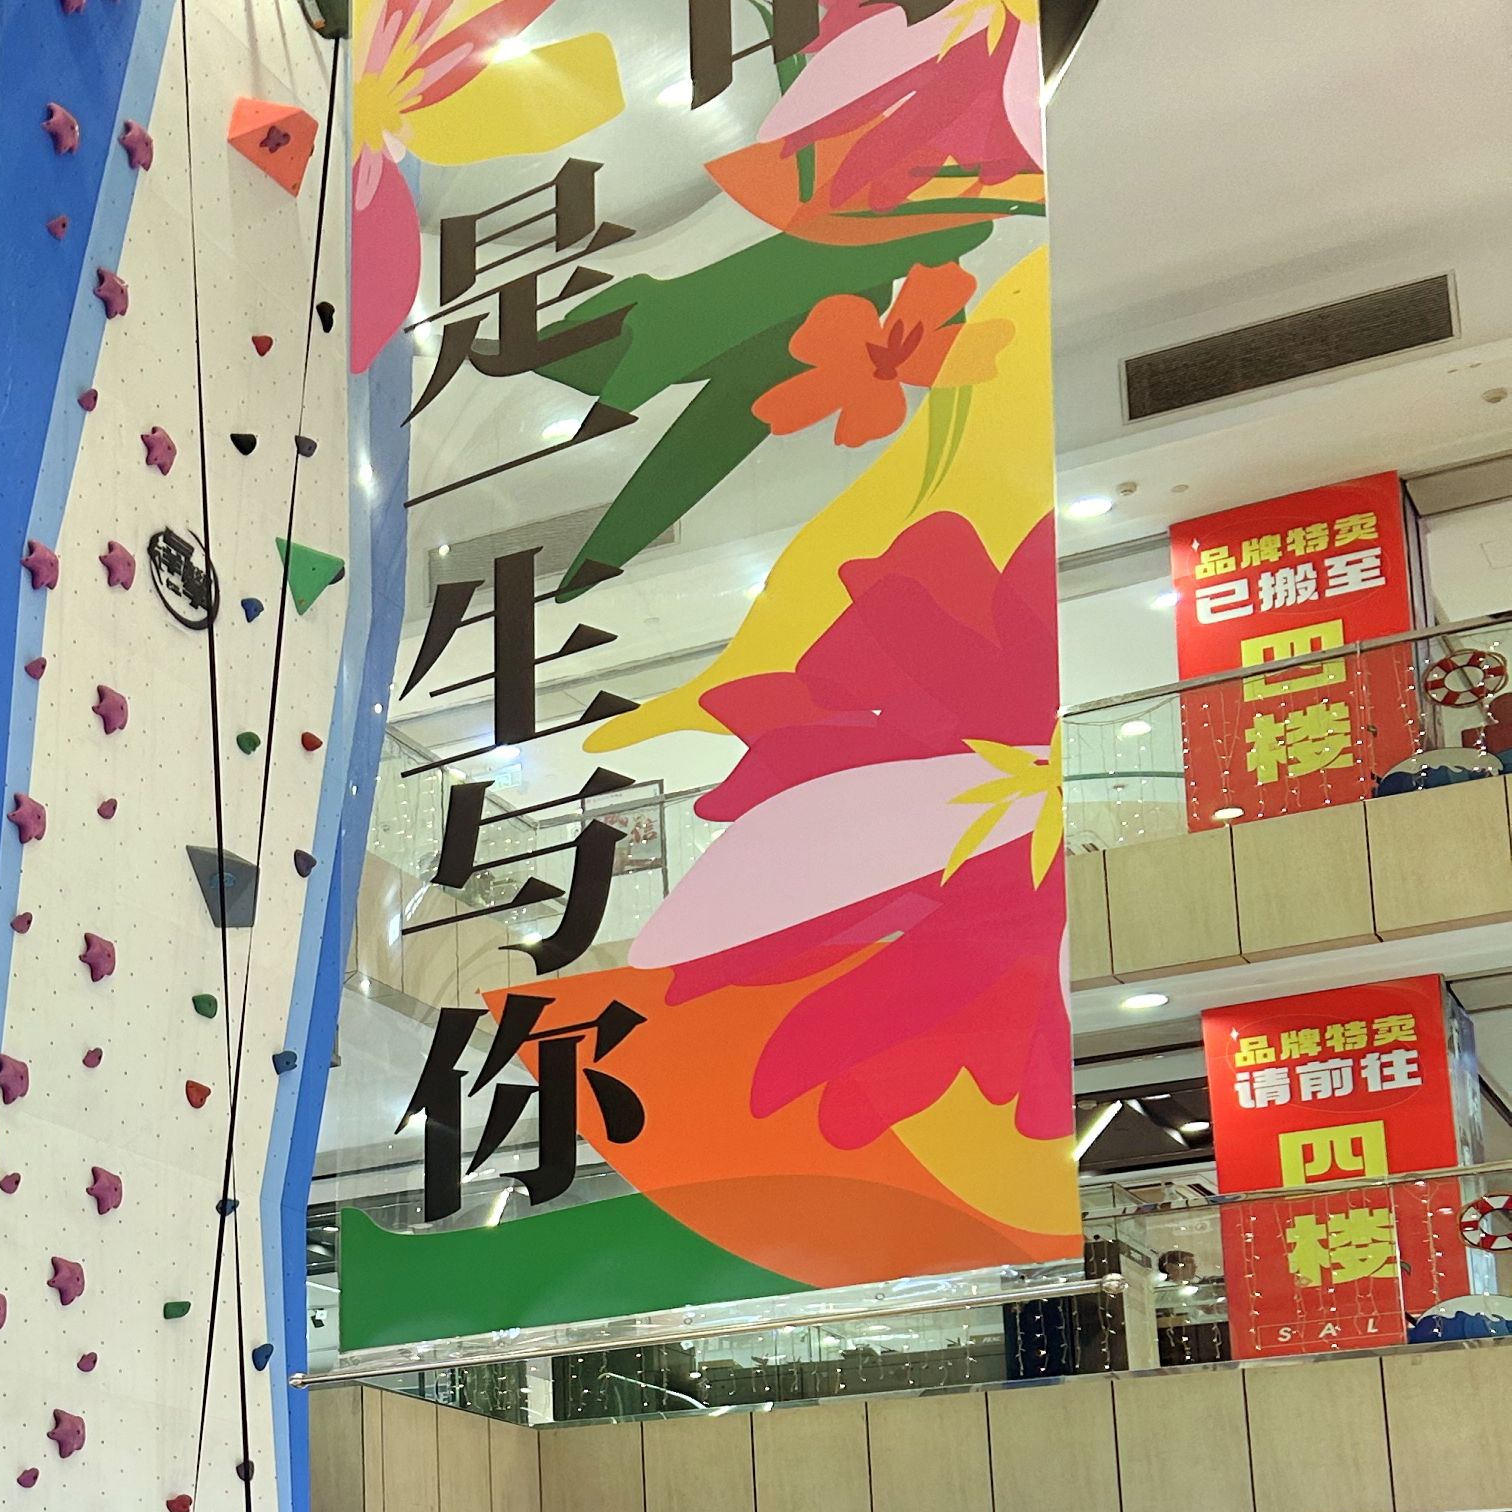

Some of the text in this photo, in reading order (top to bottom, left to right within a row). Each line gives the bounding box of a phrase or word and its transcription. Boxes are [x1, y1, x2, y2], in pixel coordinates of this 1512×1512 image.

[1195, 512, 1378, 580] 品牌特卖
[1195, 547, 1386, 625] 已搬至
[1240, 619, 1354, 784] 四楼
[1234, 1013, 1417, 1067] 品牌特卖
[1234, 1049, 1422, 1109] 请前往
[1278, 1120, 1399, 1288] 四楼
